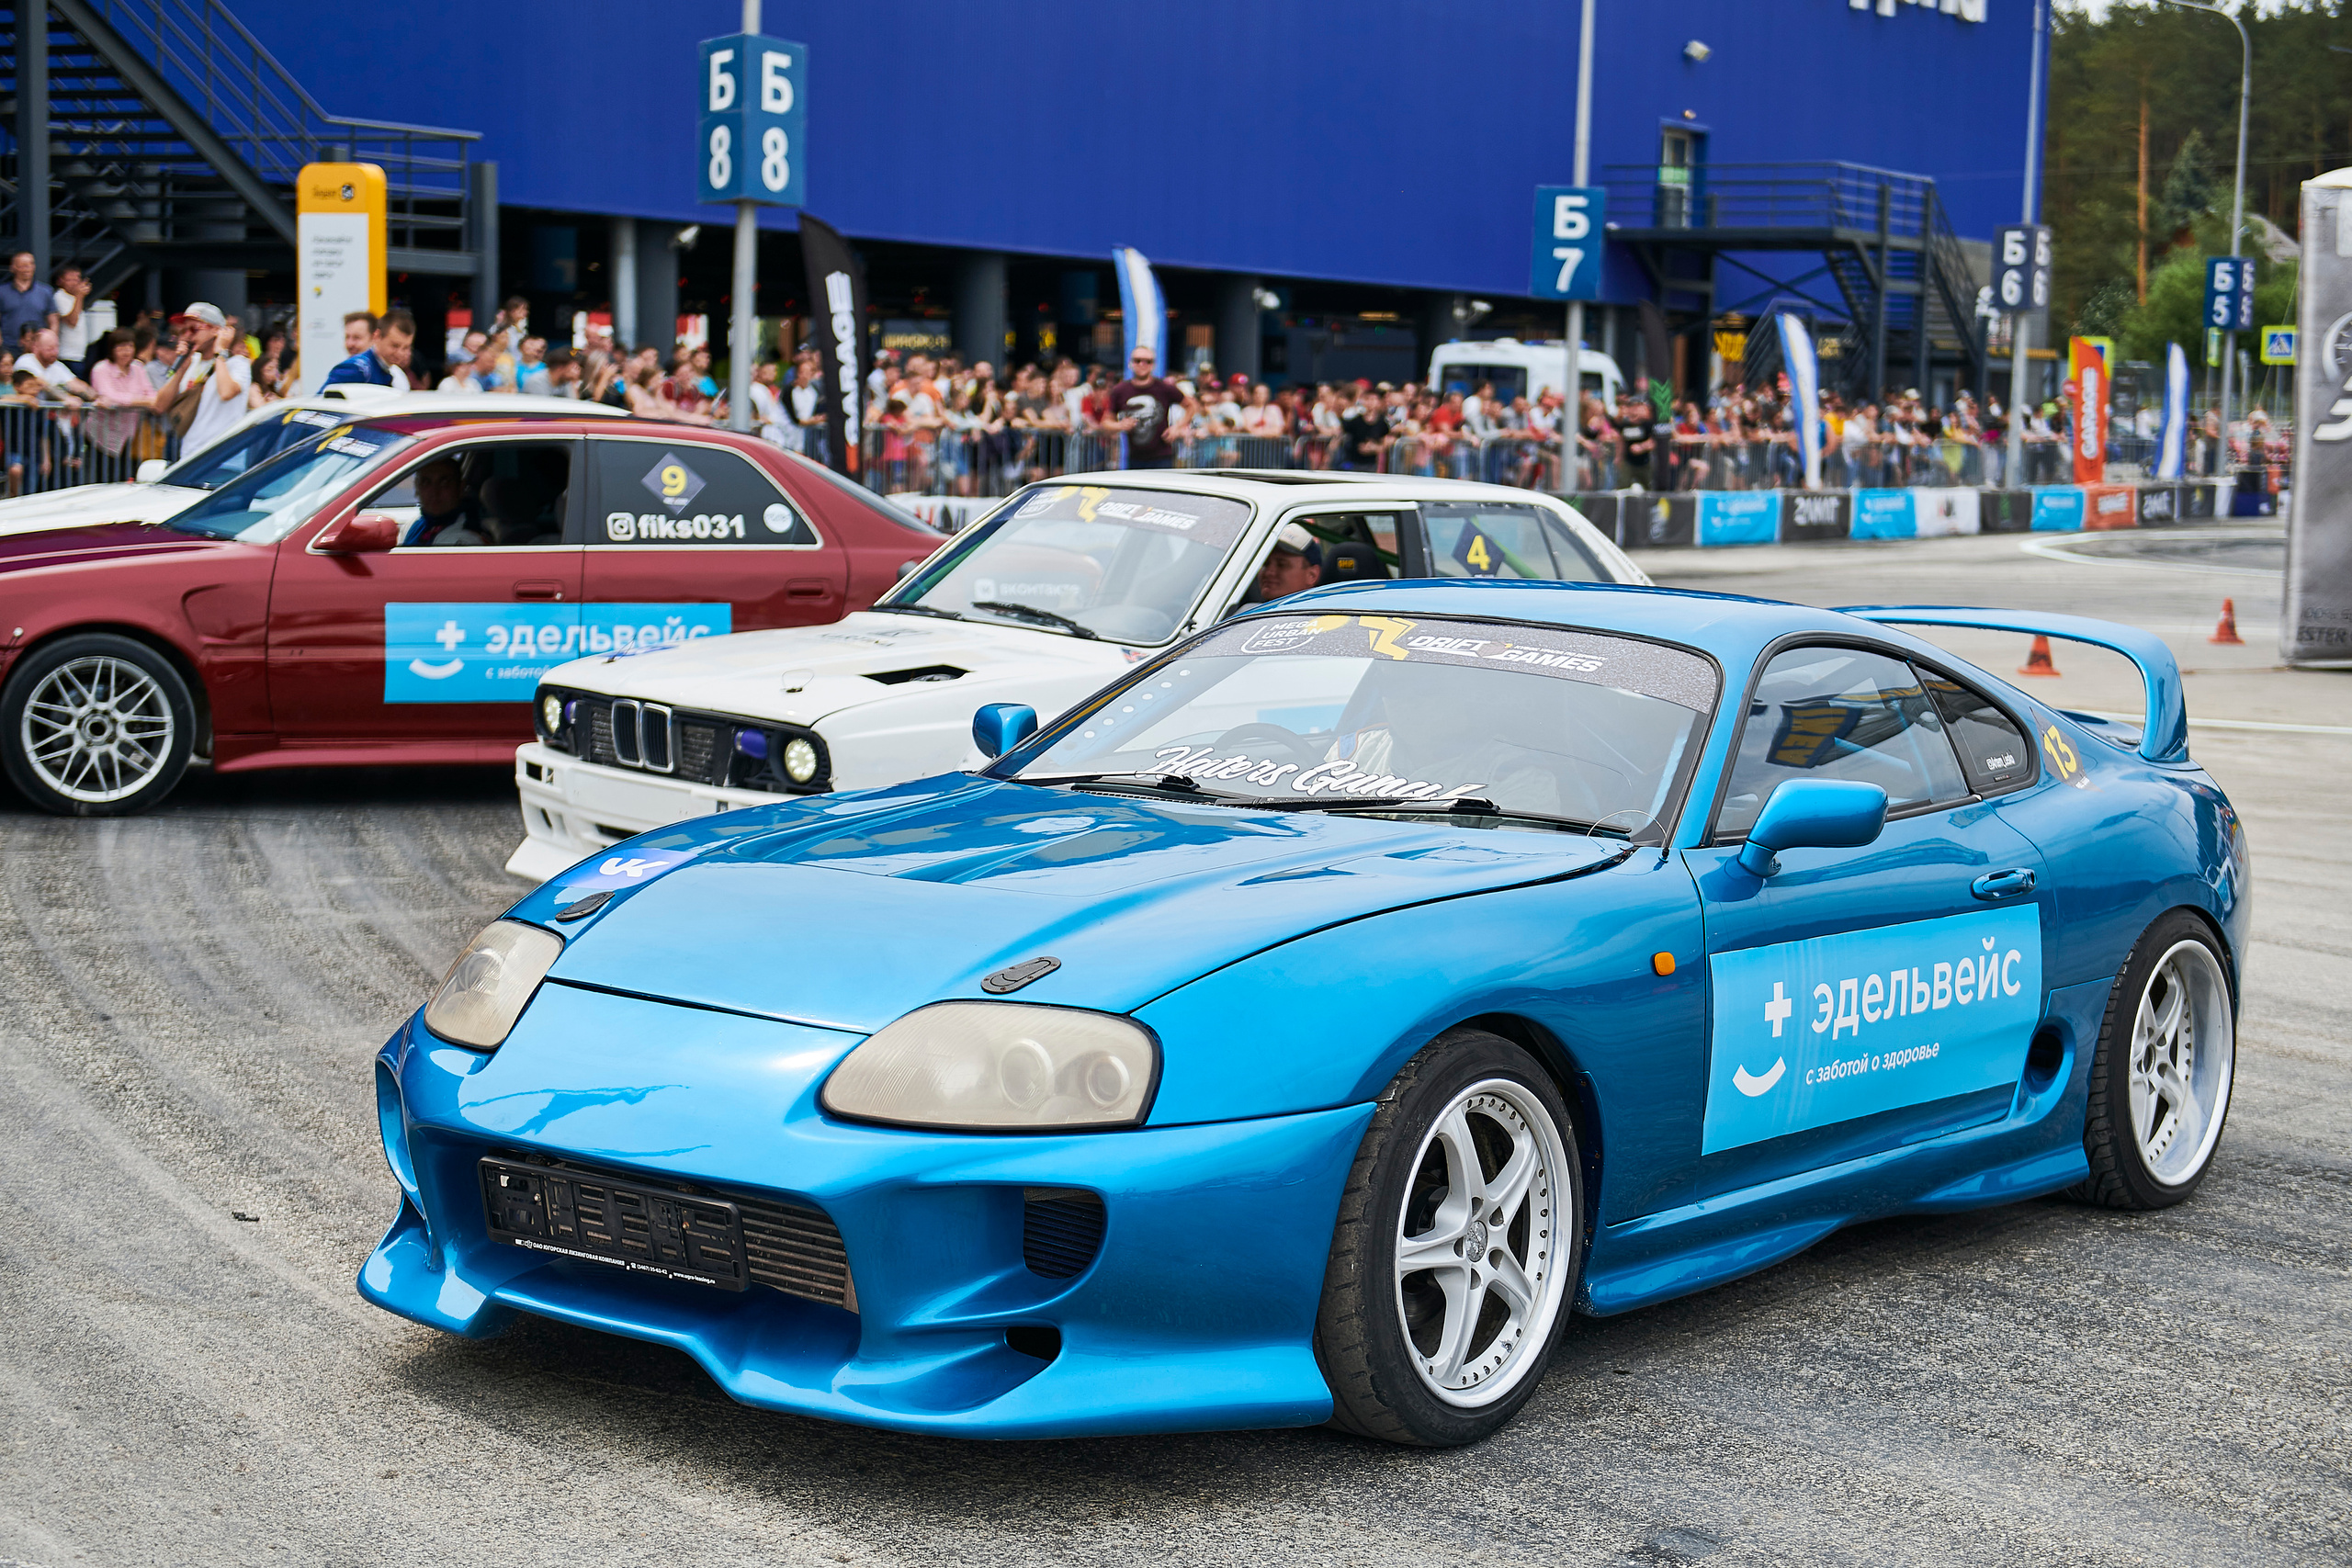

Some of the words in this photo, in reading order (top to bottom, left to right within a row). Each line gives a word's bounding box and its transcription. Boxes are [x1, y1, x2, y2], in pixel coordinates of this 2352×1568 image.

[709, 49, 736, 111] Б
[761, 50, 794, 115] Б
[708, 124, 732, 190] 8
[761, 127, 790, 193] 8
[1553, 195, 1589, 240] Б
[1553, 247, 1585, 293] 7
[2002, 269, 2022, 306] 6
[2033, 269, 2048, 307] 6
[2212, 295, 2232, 326] 5
[2240, 295, 2252, 326] 5
[661, 465, 687, 496] 9
[638, 513, 746, 539] fiks031
[1466, 535, 1491, 570] 4
[1251, 637, 1298, 649] FEST
[1261, 627, 1323, 639] URBAN
[1270, 620, 1318, 631] MEGA
[1407, 636, 1491, 651] DRIFT
[1498, 649, 1603, 672] GAMES
[1150, 746, 1299, 786] Haters
[2043, 725, 2076, 780] 13
[1811, 936, 2021, 1041] эдельвейс
[1805, 1068, 1814, 1085] с
[1815, 1053, 1868, 1082] заботой
[1871, 1055, 1880, 1070] о
[1883, 1042, 1939, 1070] здоровье
